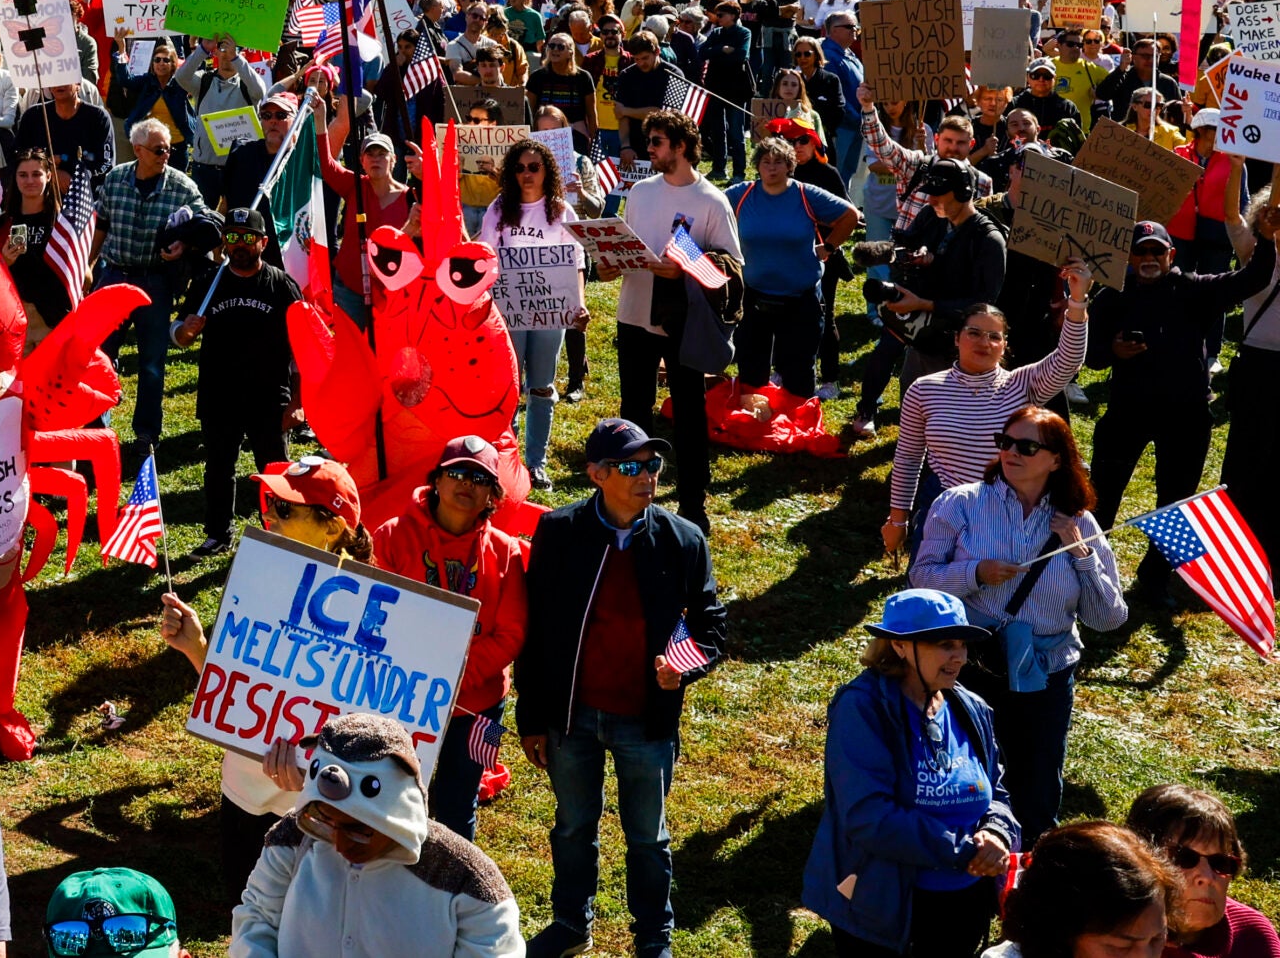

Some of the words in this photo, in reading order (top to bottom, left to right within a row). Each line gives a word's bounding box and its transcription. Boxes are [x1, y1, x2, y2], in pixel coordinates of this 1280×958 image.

[877, 3, 893, 26] I
[1236, 4, 1268, 16] DOES
[1237, 15, 1260, 26] ASS
[865, 27, 901, 50] HIS
[911, 24, 956, 47] DAD
[1240, 28, 1276, 40] MAKE
[878, 52, 949, 75] HUGGED
[1230, 63, 1271, 82] Wake
[912, 75, 962, 99] MORE
[1221, 83, 1248, 145] SAVE
[1102, 201, 1113, 212] AS
[1031, 196, 1072, 230] LOVE
[1076, 212, 1098, 237] THIS
[1098, 219, 1133, 253] PLACE
[511, 227, 544, 239] GAZA
[498, 245, 574, 268] PROTEST?
[517, 270, 545, 284] IT'S
[515, 285, 551, 298] THAN
[212, 298, 272, 314] ANTIFASCIST
[506, 302, 514, 311] A
[521, 297, 566, 311] FAMILY
[533, 311, 573, 326] ATTIC
[288, 563, 400, 652] ICE
[215, 611, 330, 688] MELTS
[332, 653, 452, 731] UNDER
[916, 784, 960, 796] FRONT
